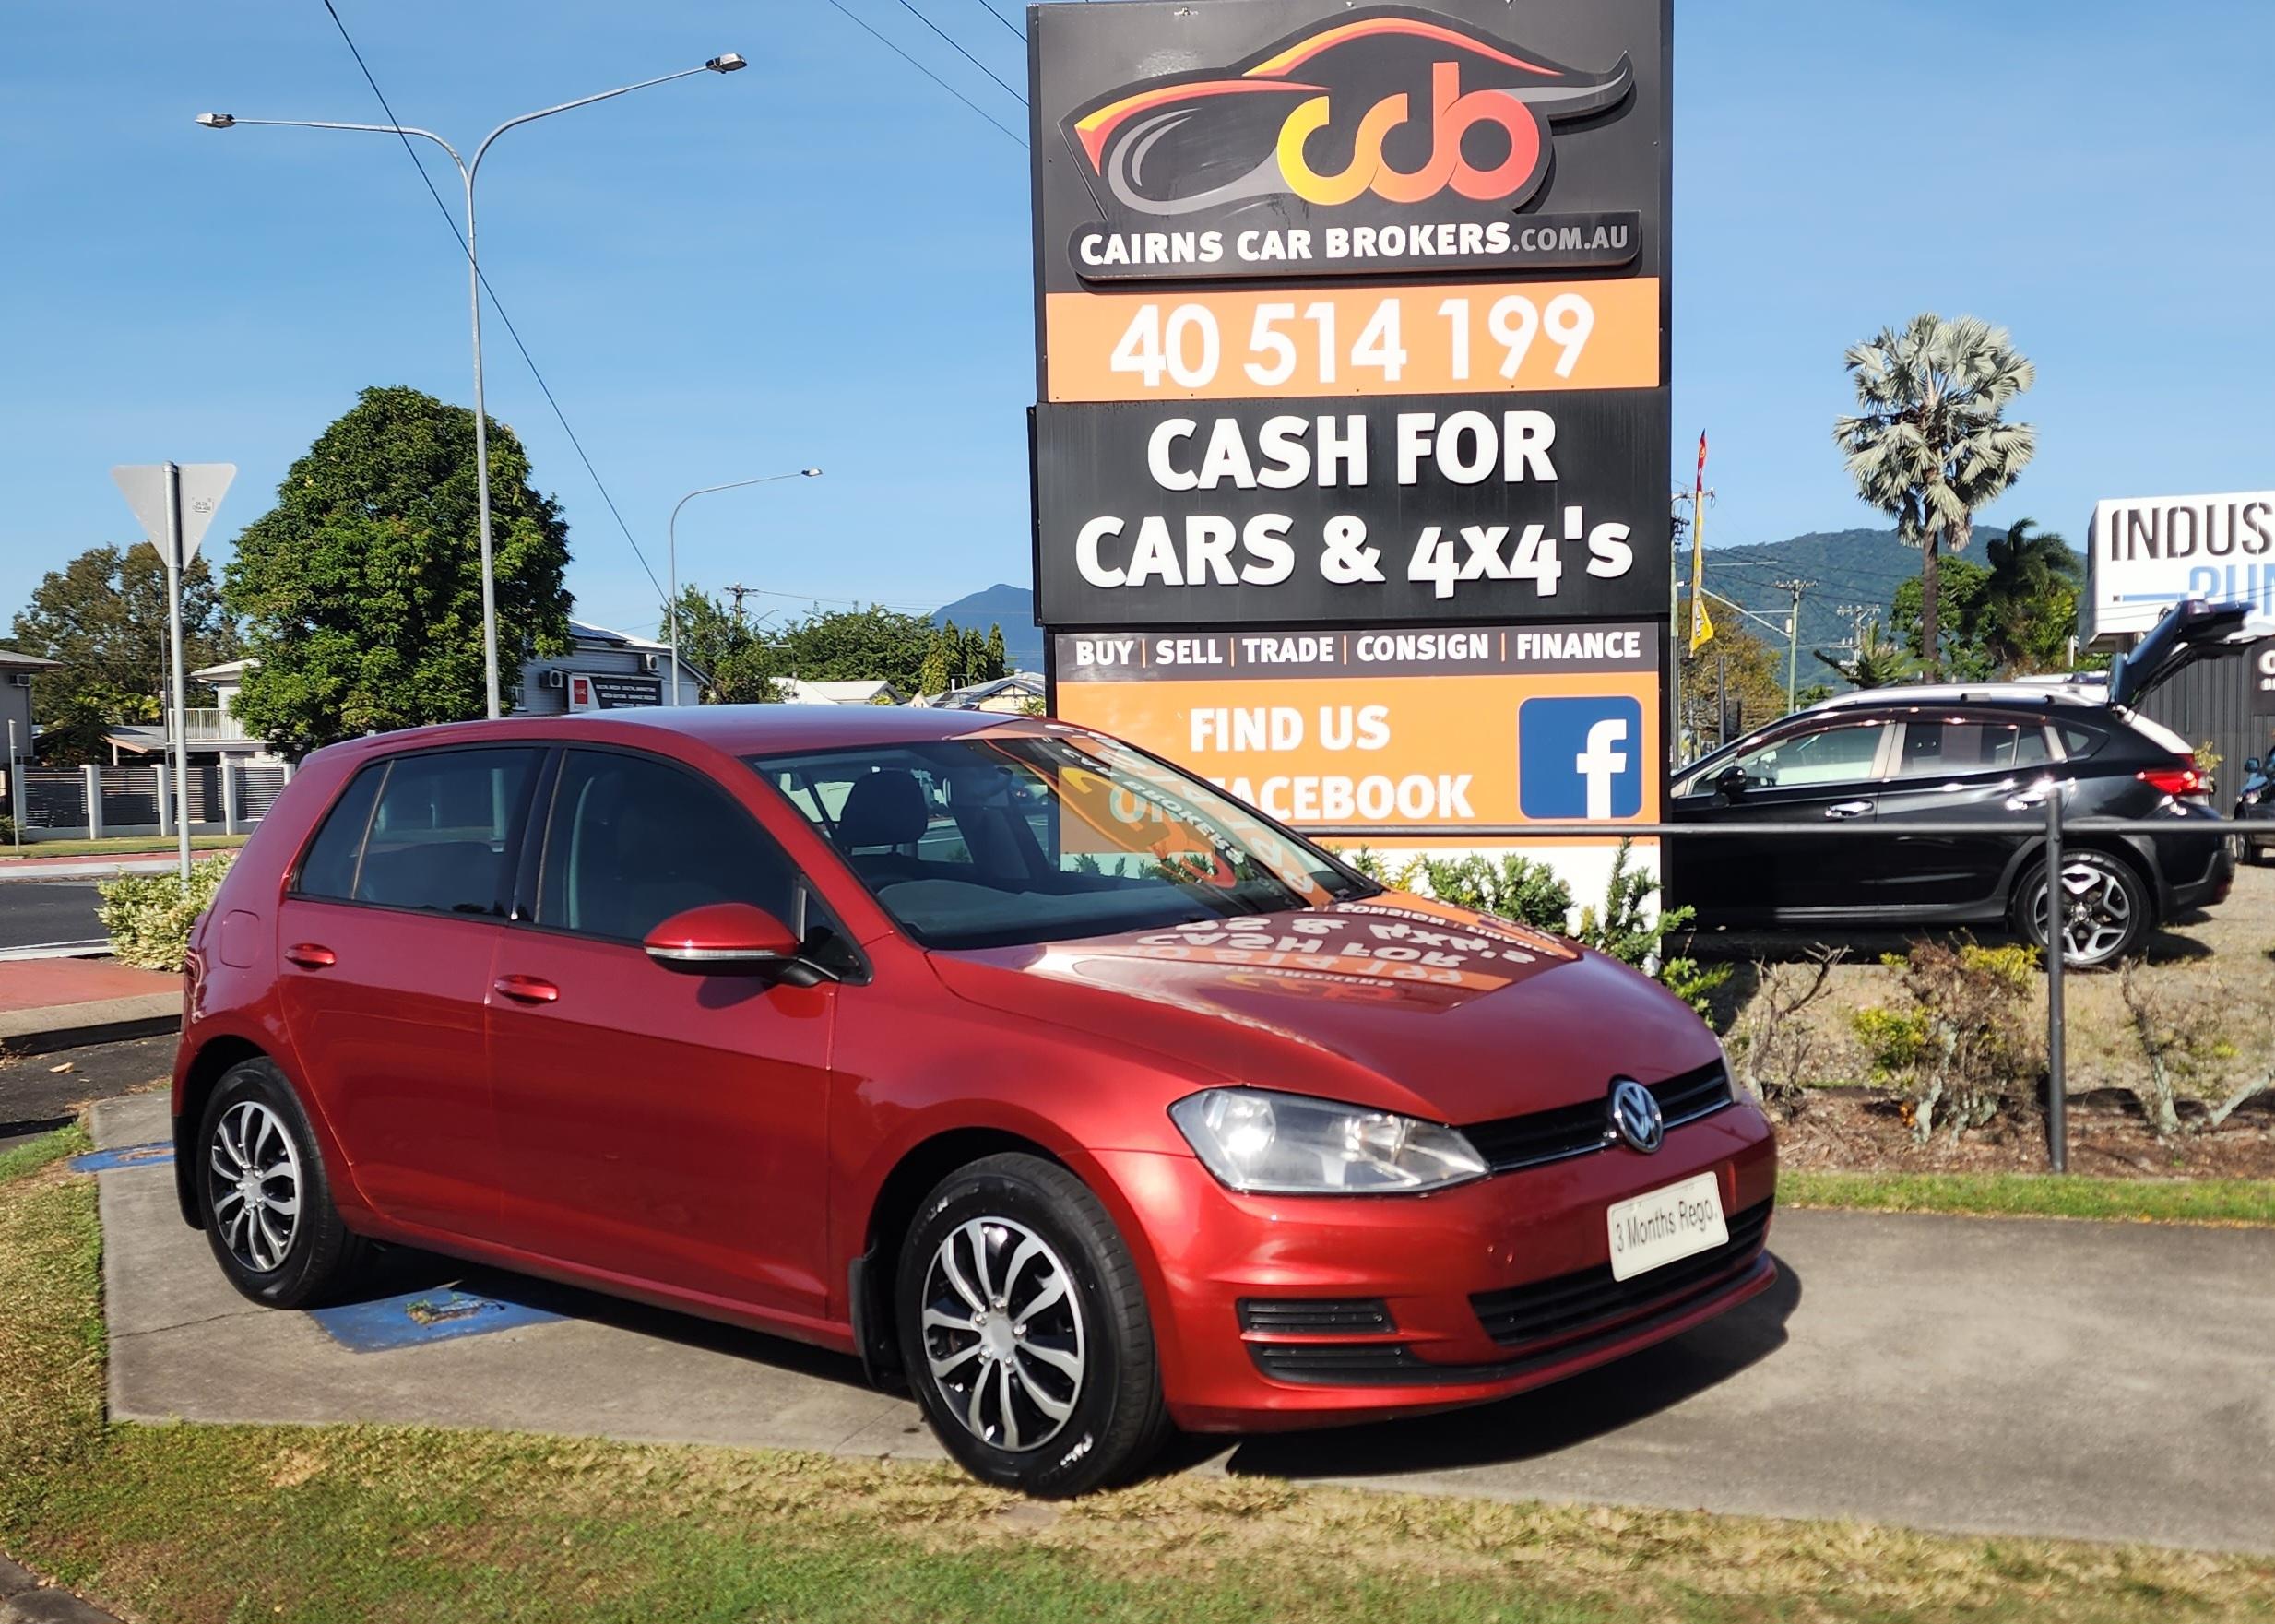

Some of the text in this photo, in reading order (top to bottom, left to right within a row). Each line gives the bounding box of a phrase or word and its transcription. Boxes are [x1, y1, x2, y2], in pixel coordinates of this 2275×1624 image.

[1080, 231, 1223, 266] CAIRNS
[1237, 228, 1313, 262] CAR
[1110, 293, 1594, 388] 40 514 199
[1148, 411, 1557, 490] CASH FOR
[1076, 514, 1294, 587] CARS
[1320, 515, 1386, 584] &
[1075, 632, 1641, 666] BUY SELL TRADE CONSIGN FINANCE
[1190, 705, 1391, 752] FIND US
[1206, 775, 1475, 820] ACEBOOK
[1616, 1222, 1624, 1252] 3
[1627, 1207, 1677, 1249] Months
